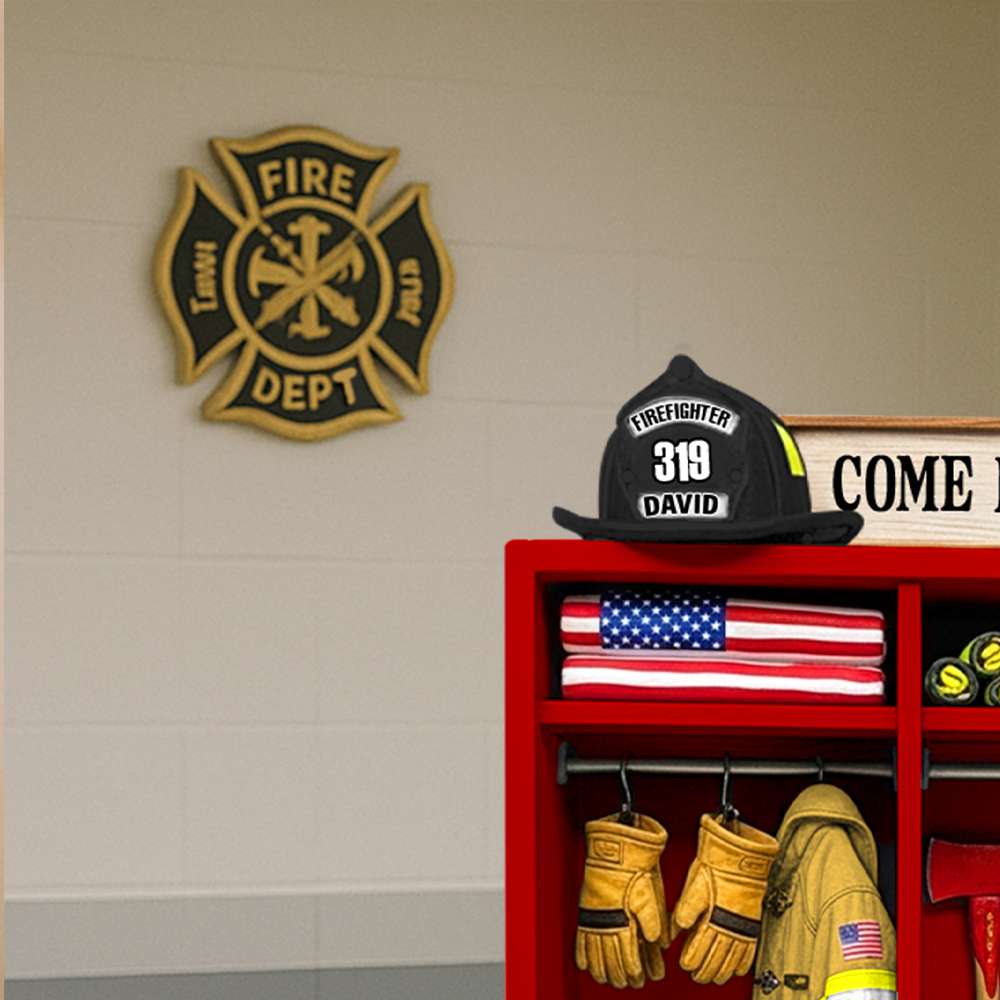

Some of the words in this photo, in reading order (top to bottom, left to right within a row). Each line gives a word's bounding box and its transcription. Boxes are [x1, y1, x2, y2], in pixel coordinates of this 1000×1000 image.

[256, 157, 355, 205] FIRE
[251, 366, 358, 411] DEPT
[630, 402, 732, 432] FIREFIGHTER
[653, 439, 711, 483] 319
[643, 493, 719, 517] DAVID
[832, 455, 974, 513] COME
